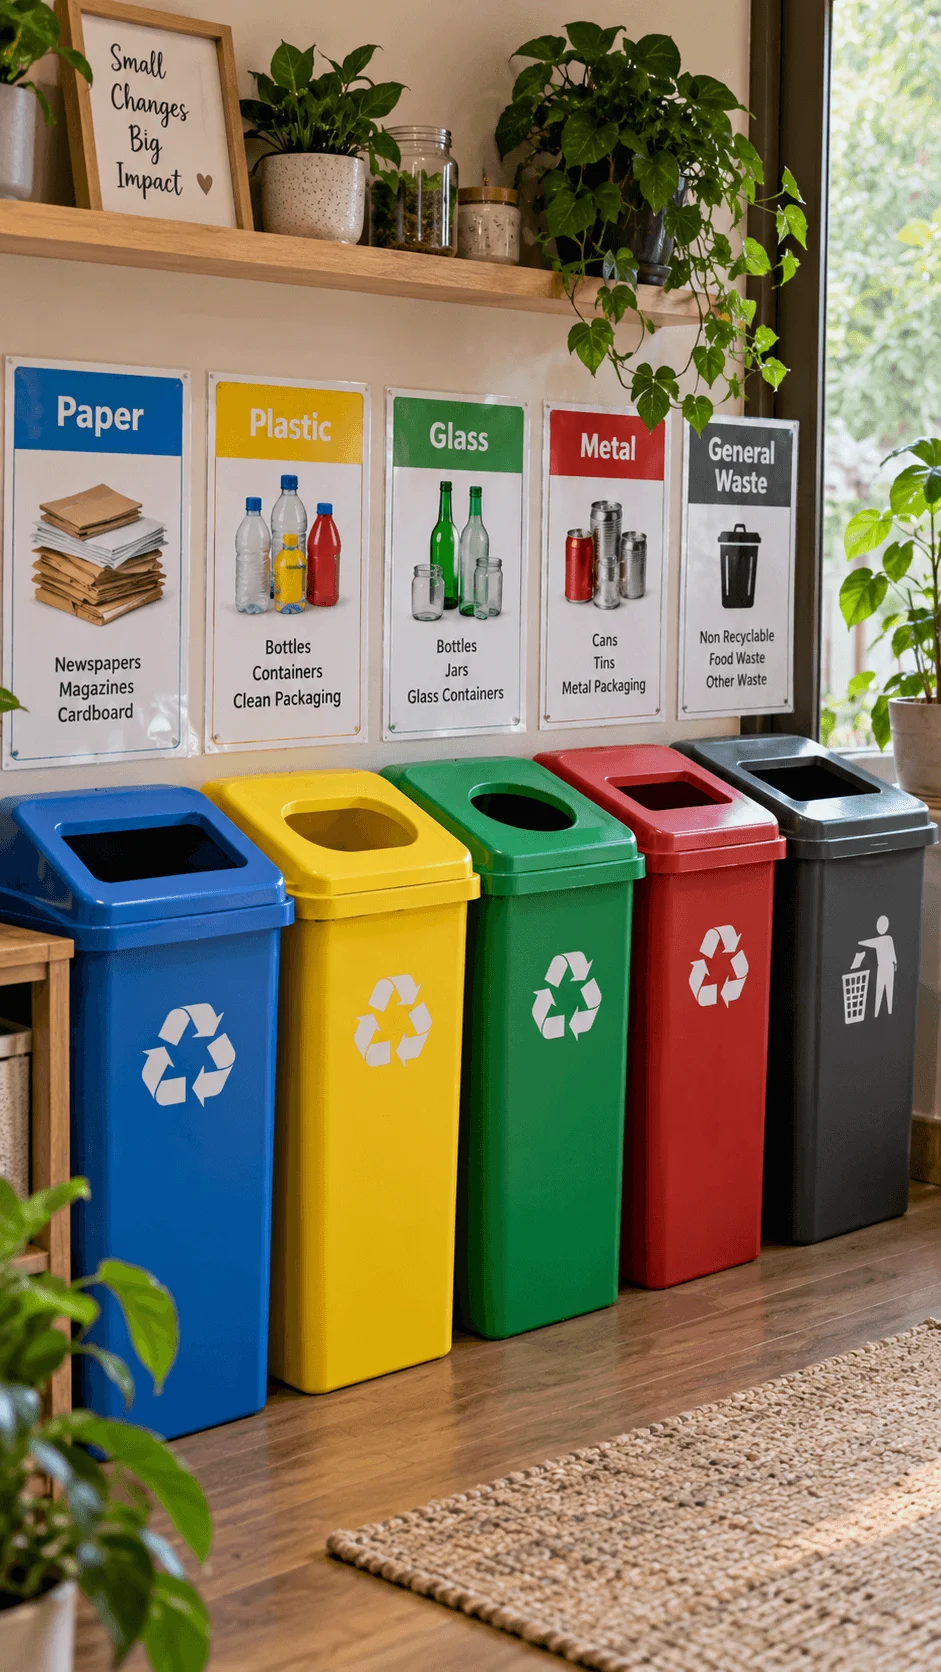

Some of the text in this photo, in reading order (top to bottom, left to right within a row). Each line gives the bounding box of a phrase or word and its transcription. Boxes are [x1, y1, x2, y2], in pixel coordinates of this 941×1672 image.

[110, 43, 167, 79] Small
[111, 83, 189, 128] Changes
[128, 124, 162, 165] Big
[116, 161, 183, 199] Impact
[58, 396, 144, 437] Paper
[251, 408, 331, 441] Plastic
[430, 422, 488, 451] Glass
[581, 433, 635, 460] Metal
[709, 437, 774, 464] General
[715, 469, 767, 493] Waste
[266, 638, 311, 654] Bottles
[437, 638, 477, 653] Bottles
[593, 634, 617, 647] Cans
[700, 629, 774, 646] Non Recyclable
[55, 656, 141, 675] Newspapers
[594, 656, 615, 669] Tins
[710, 652, 765, 665] Food Waste
[253, 664, 322, 681] Containers
[445, 663, 468, 677] Jars
[60, 679, 134, 700] Magazines
[562, 678, 645, 695] Metal Packaging
[707, 674, 767, 688] Other Waste
[233, 689, 342, 708] Clean Packaging
[408, 686, 503, 704] Glass Containers
[58, 703, 133, 722] Cardboard
